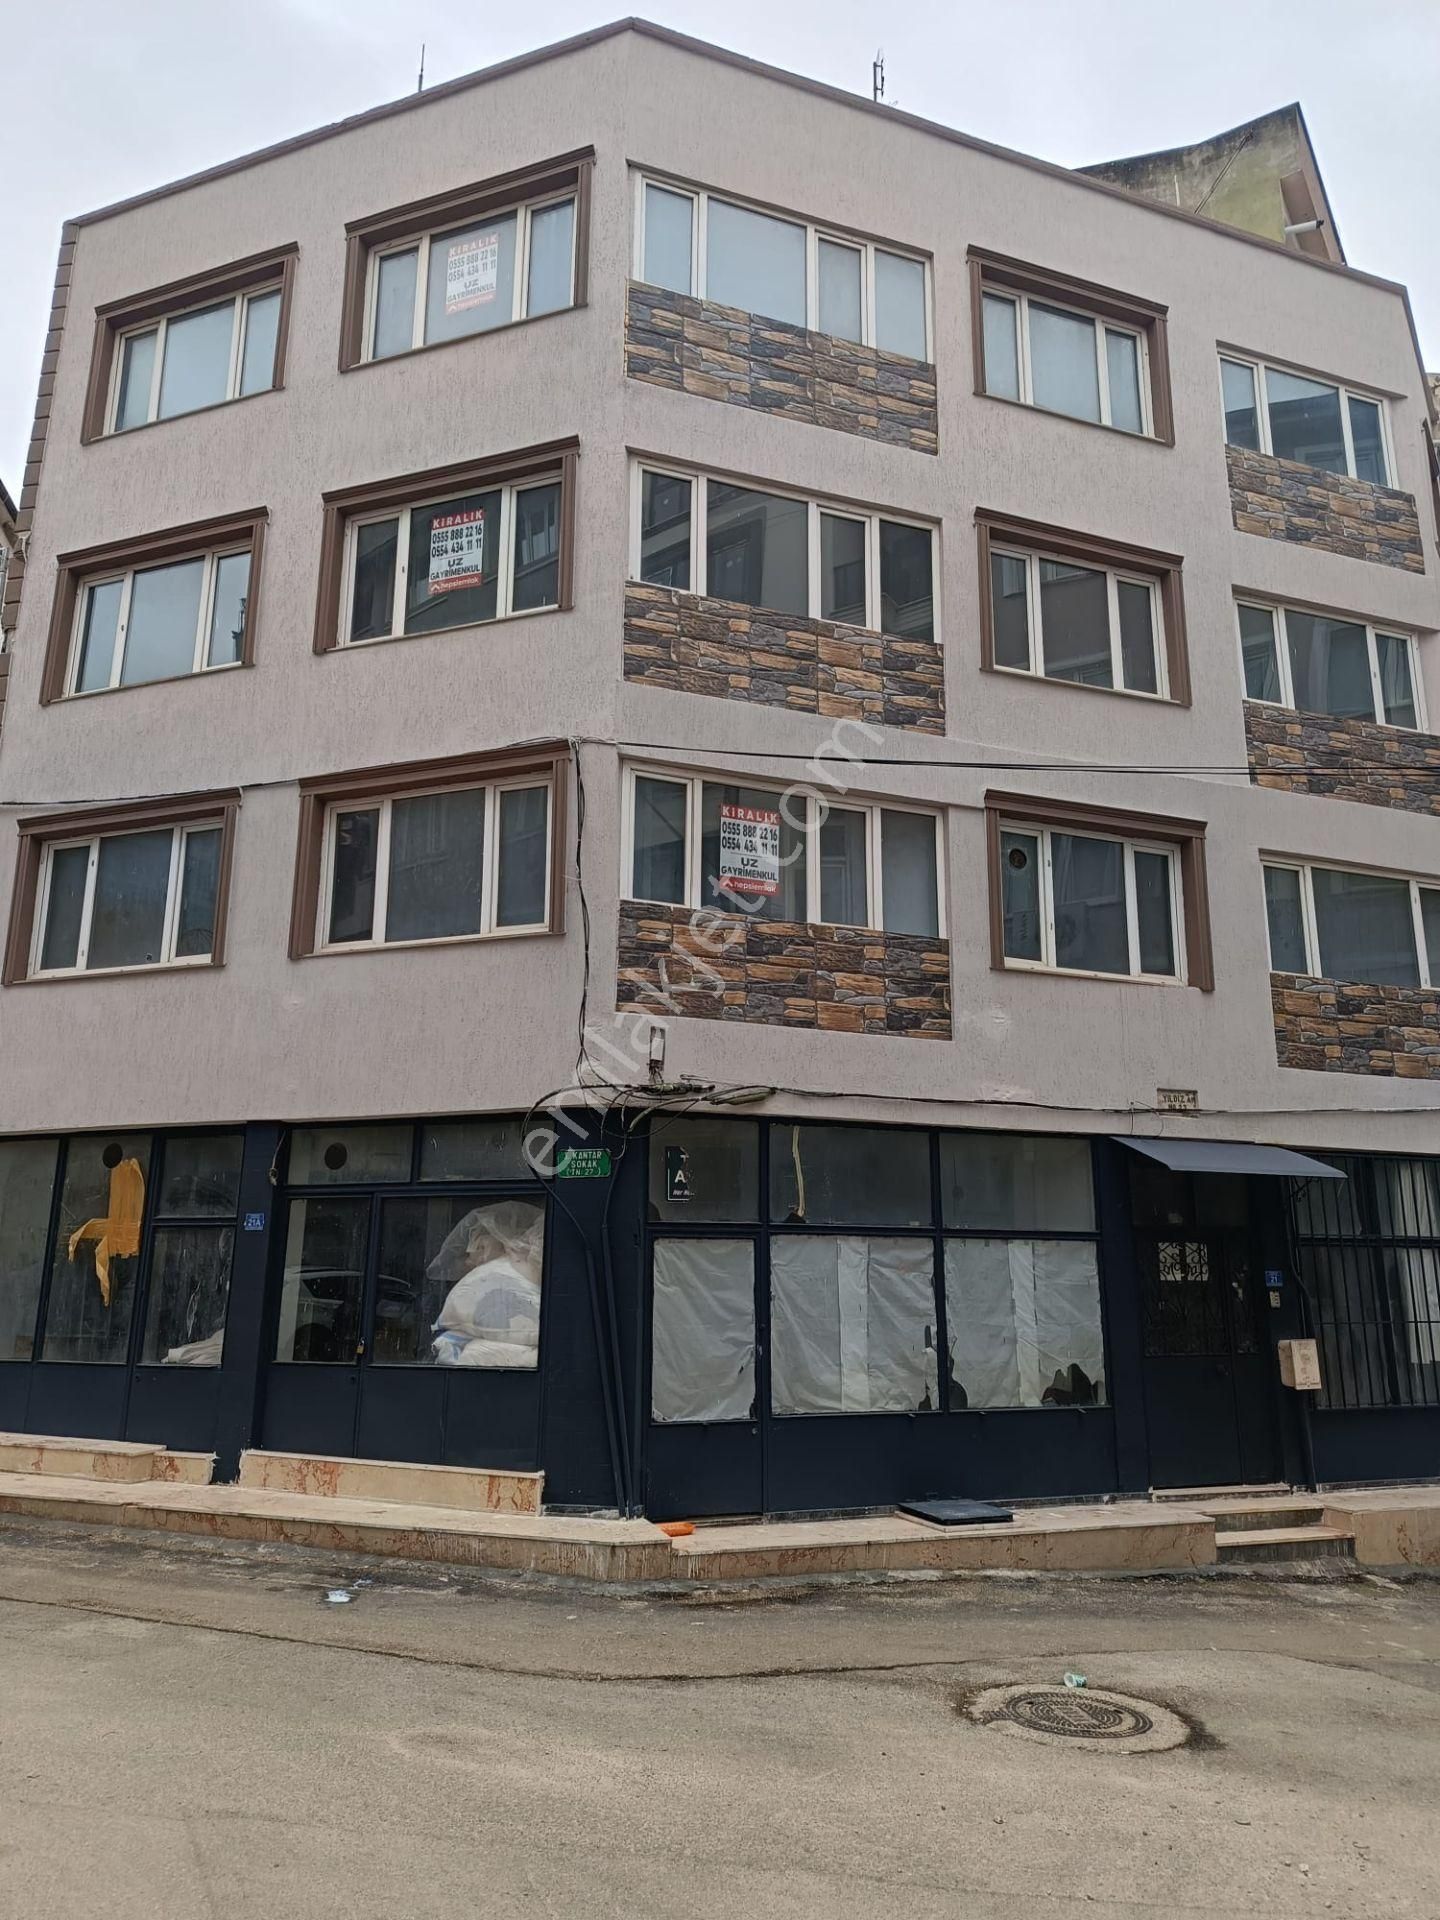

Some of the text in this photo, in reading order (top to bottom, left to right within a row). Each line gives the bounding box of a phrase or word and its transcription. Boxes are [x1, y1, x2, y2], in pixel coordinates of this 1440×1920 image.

[449, 235, 497, 257] KIRALIK
[449, 256, 465, 271] 0555
[481, 249, 489, 261] 22
[448, 269, 465, 282] 0554
[482, 262, 488, 273] 11
[490, 260, 496, 270] 11
[464, 278, 479, 289] UZ
[433, 509, 483, 529] KIRALIK
[432, 524, 482, 544] 0555 888 22 16
[431, 538, 482, 558] 0554 434 11 11
[447, 557, 463, 567] UZ
[722, 805, 778, 824] KIRALIK
[721, 821, 778, 842] 0555 888 22 16
[721, 836, 778, 857] 0554 434 11 11
[740, 857, 758, 868] UZ
[570, 1160, 597, 1169] SOKAK
